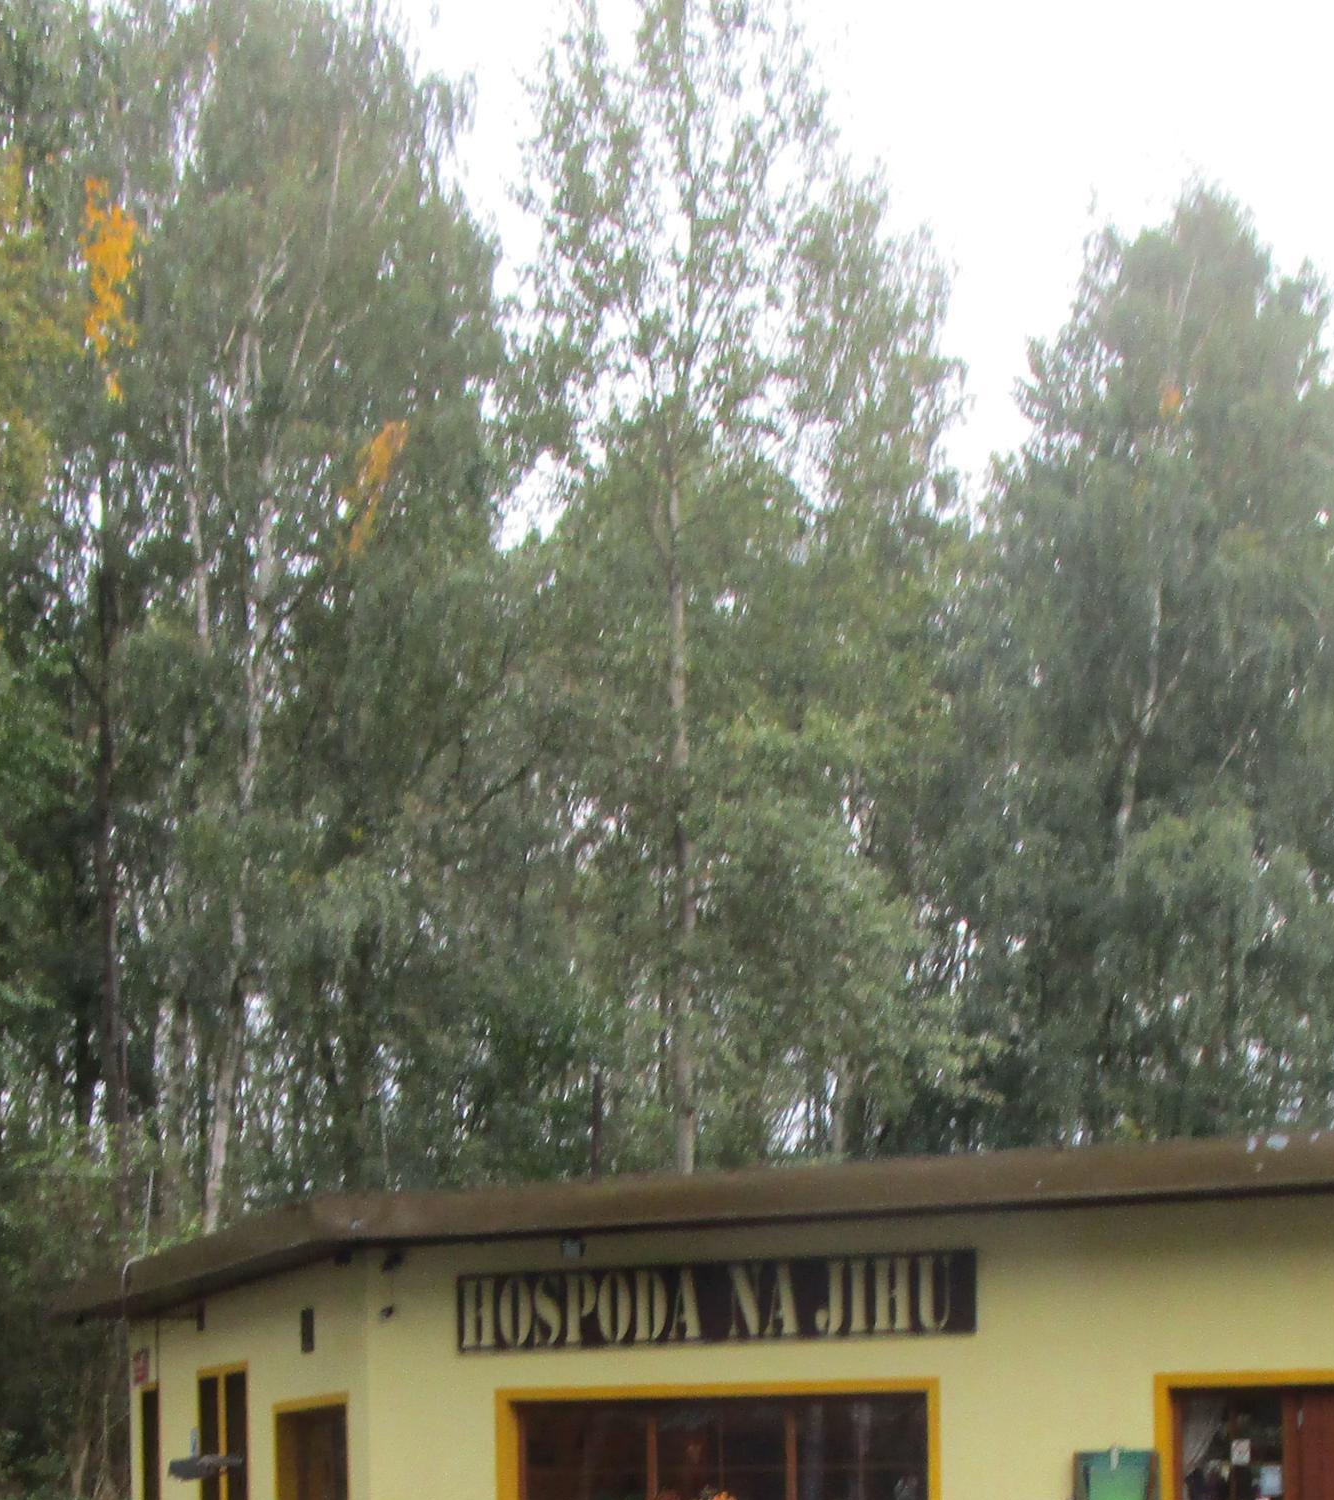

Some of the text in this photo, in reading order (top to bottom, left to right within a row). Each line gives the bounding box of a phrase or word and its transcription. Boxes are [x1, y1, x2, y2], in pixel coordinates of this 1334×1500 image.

[462, 1254, 952, 1348] HOSPODA NA JIHU
